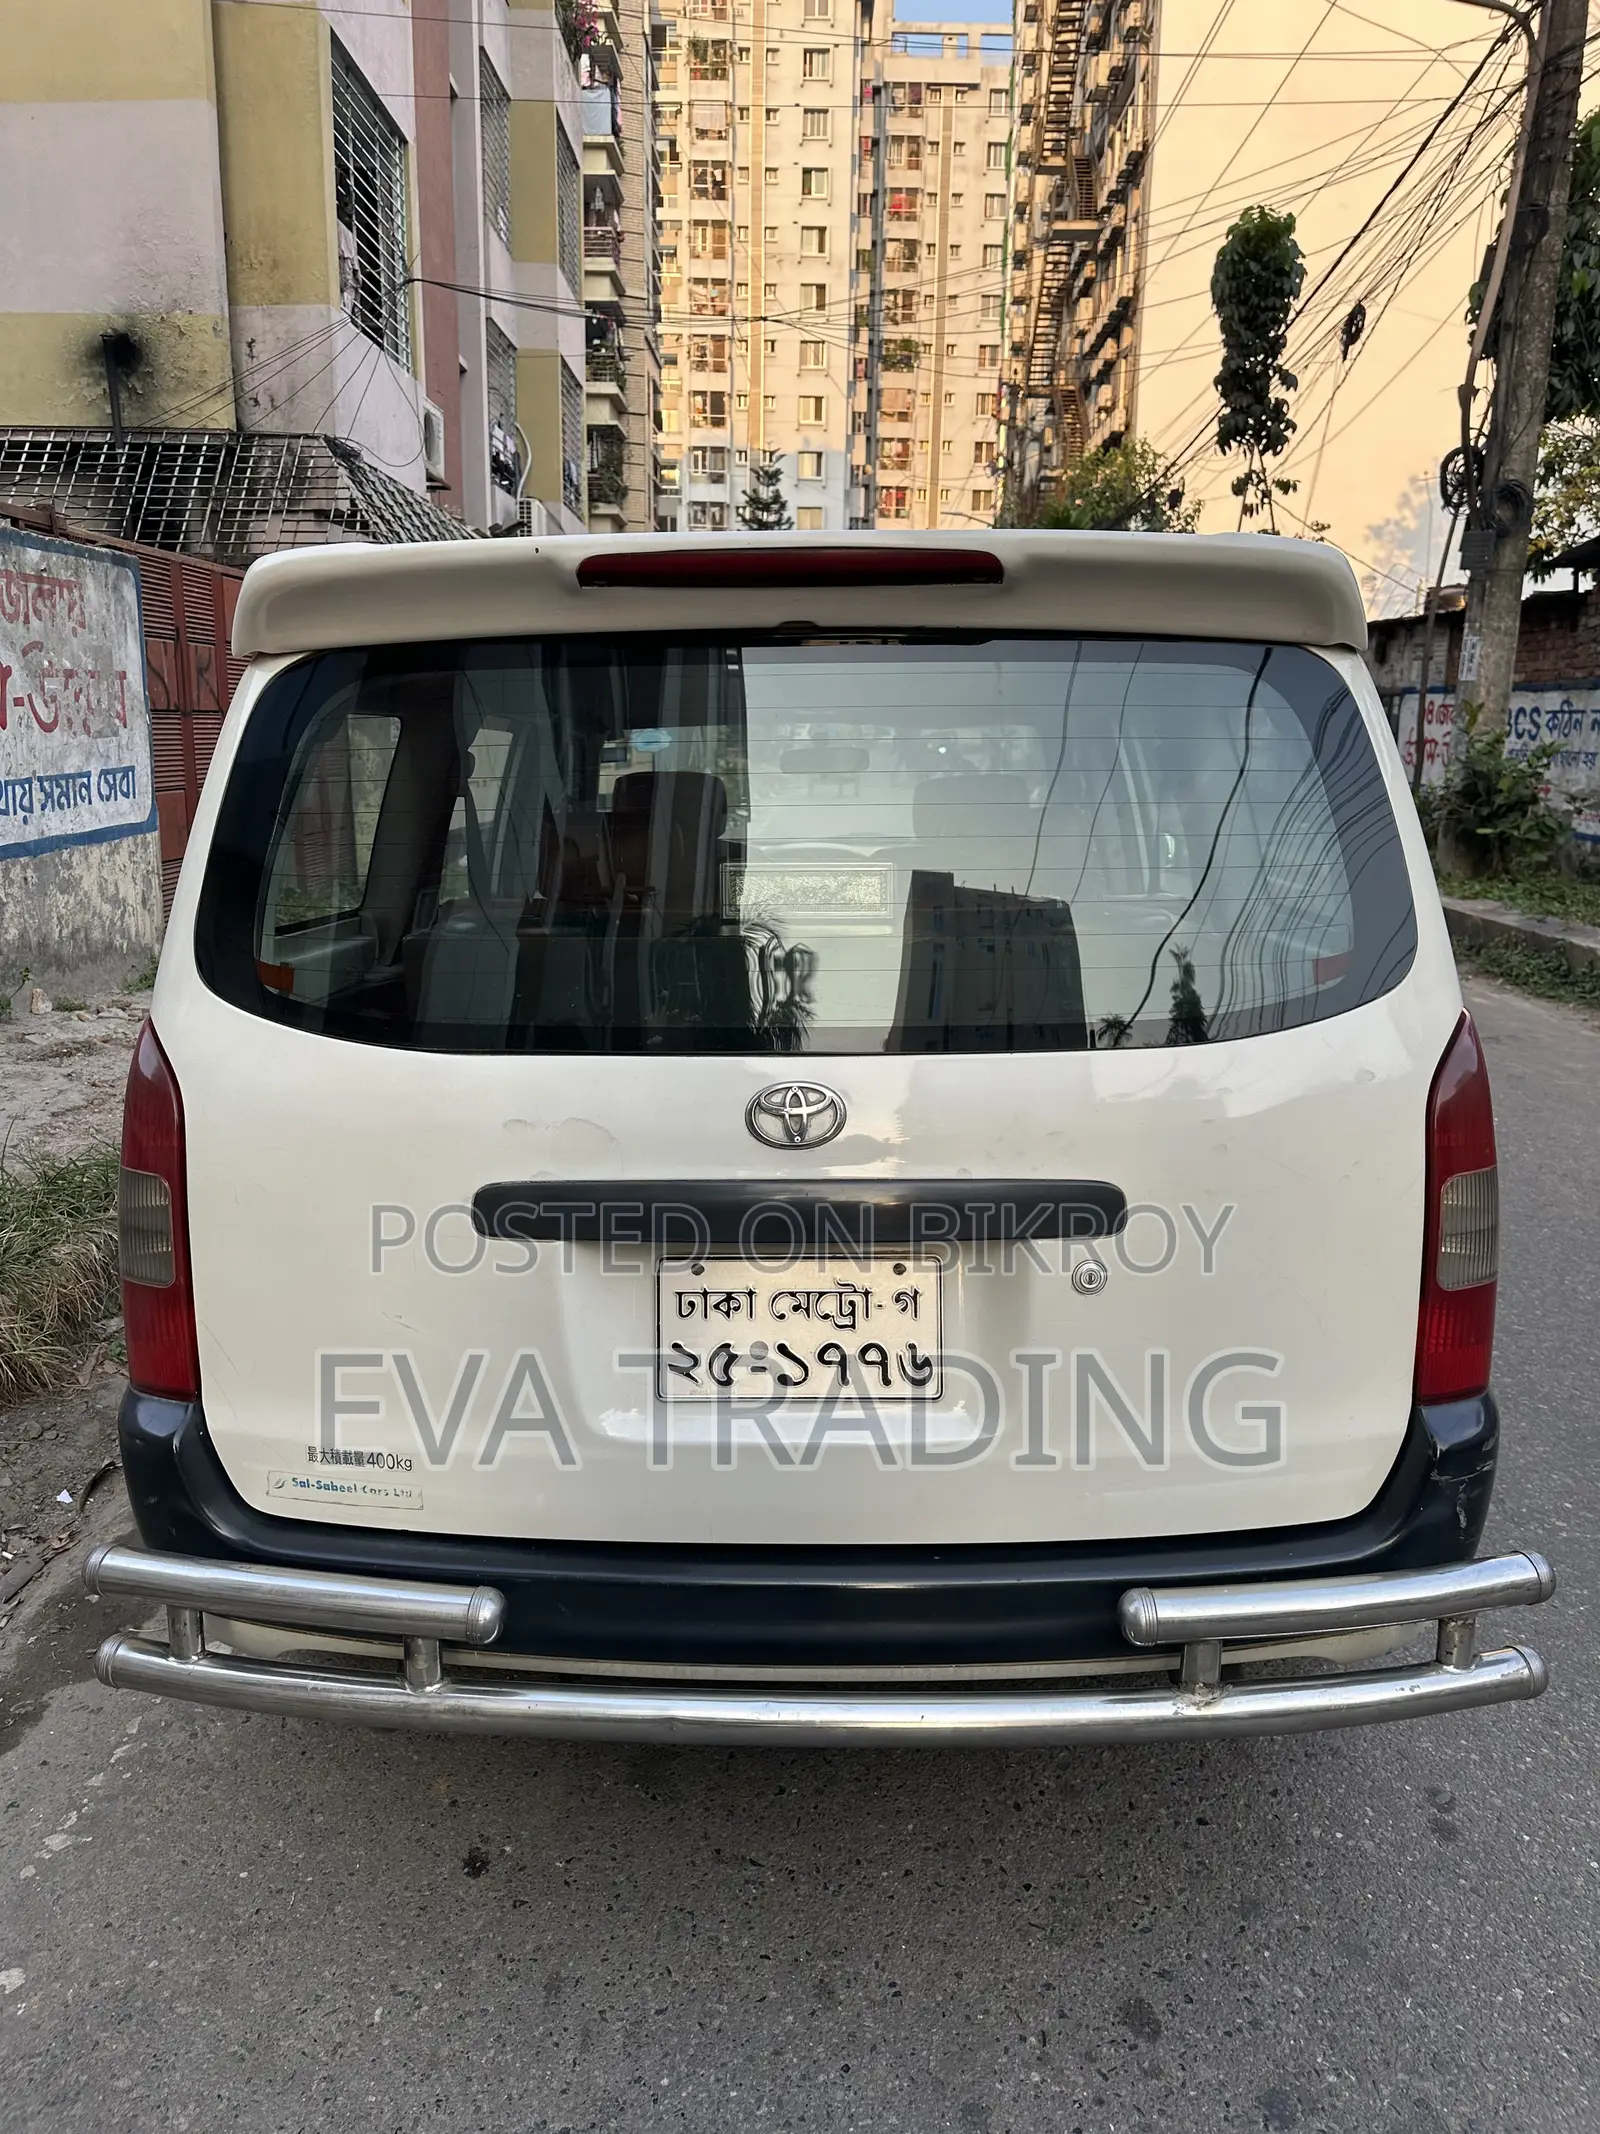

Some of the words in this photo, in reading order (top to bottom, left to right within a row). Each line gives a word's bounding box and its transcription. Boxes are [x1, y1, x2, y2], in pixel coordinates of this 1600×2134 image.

[1545, 696, 1587, 737] কঠিন
[37, 771, 92, 812] সমান
[97, 765, 136, 802] সেবা
[674, 1284, 758, 1321] ঢাকা
[668, 1340, 934, 1388] ২৫-১৭৭৬
[292, 1477, 357, 1493] Sal-Sabeel
